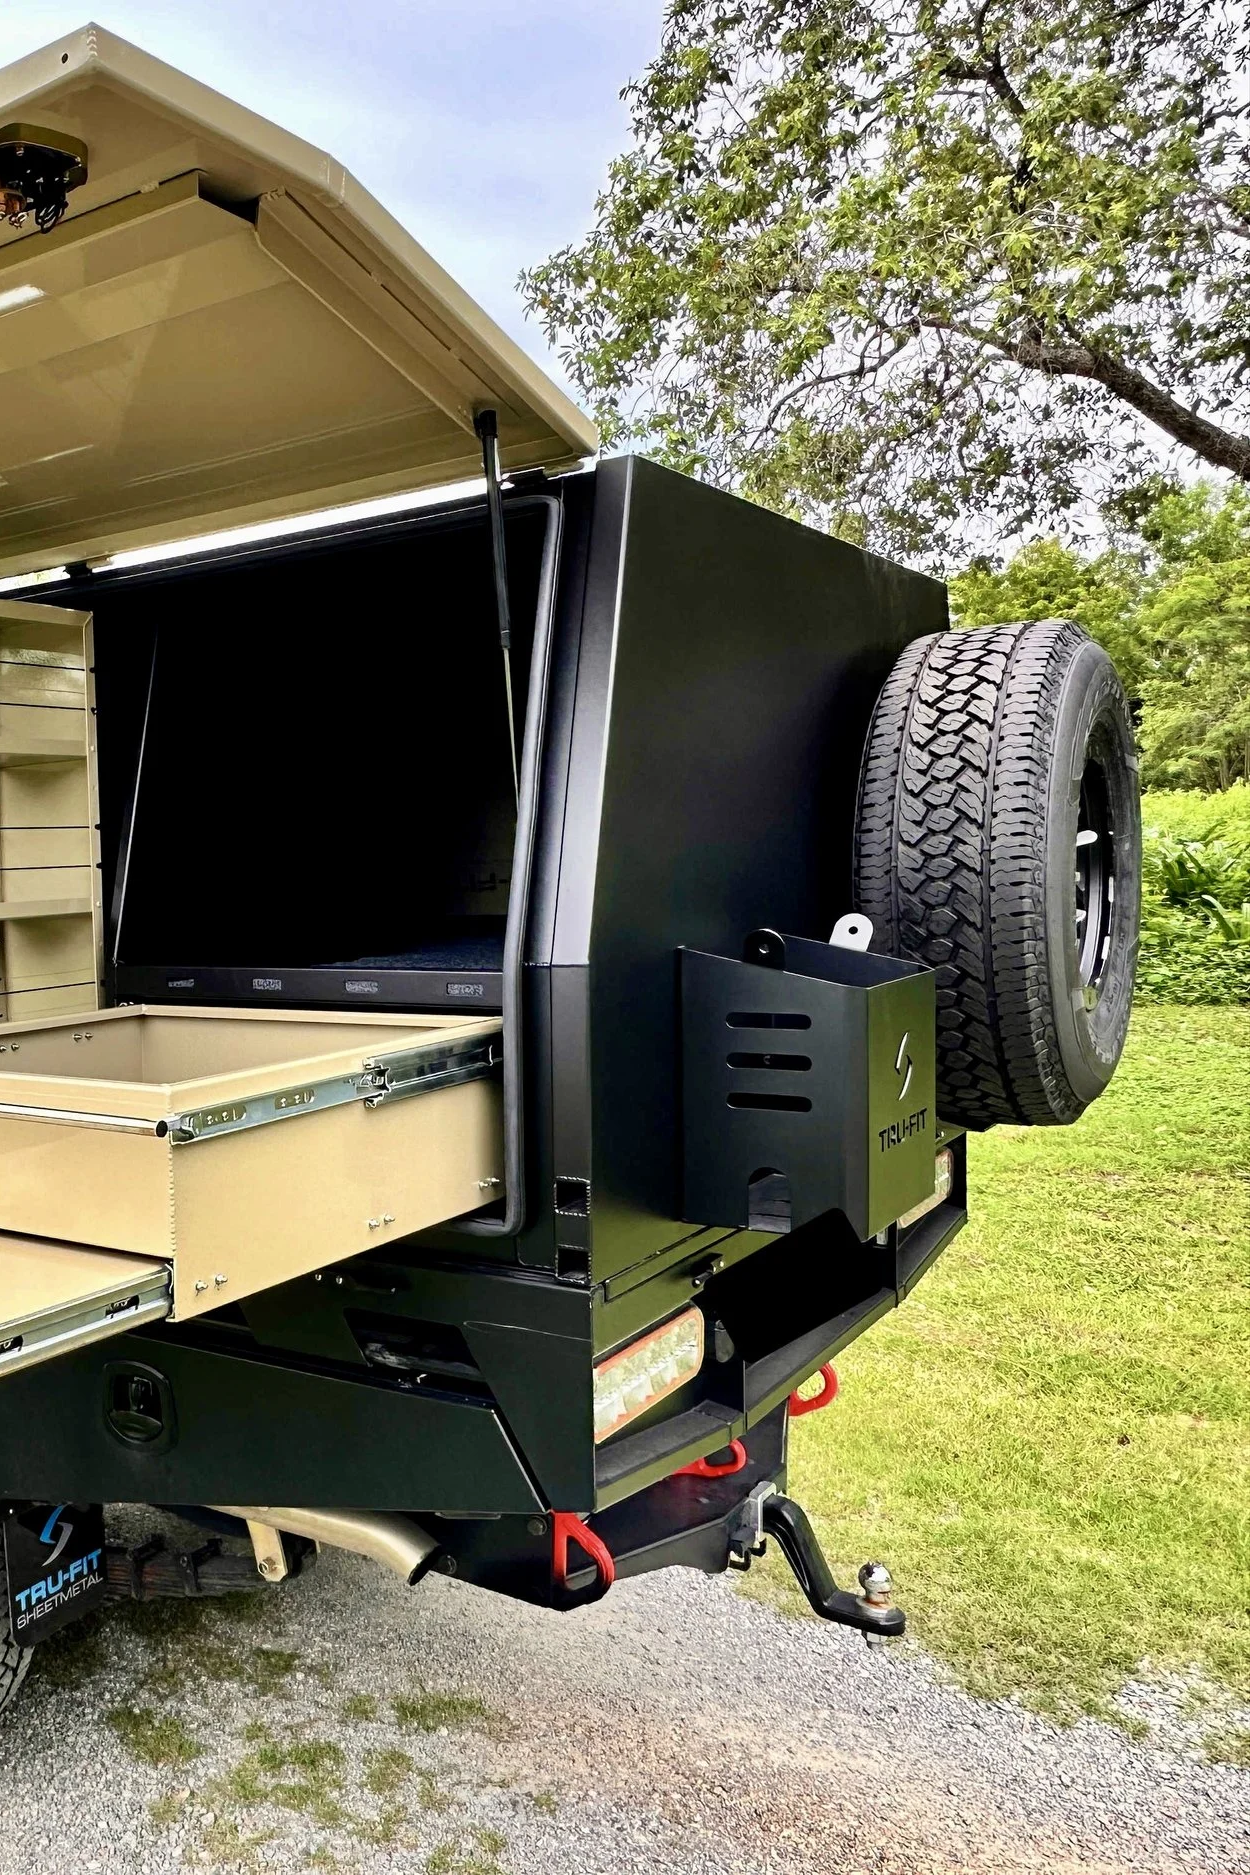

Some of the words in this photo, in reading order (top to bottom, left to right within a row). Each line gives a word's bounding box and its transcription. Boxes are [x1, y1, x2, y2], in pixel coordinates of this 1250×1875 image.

[879, 1108, 927, 1152] TRU-FIT
[15, 1548, 102, 1611] TRU-FIT
[17, 1571, 103, 1629] SHEETMETAL
